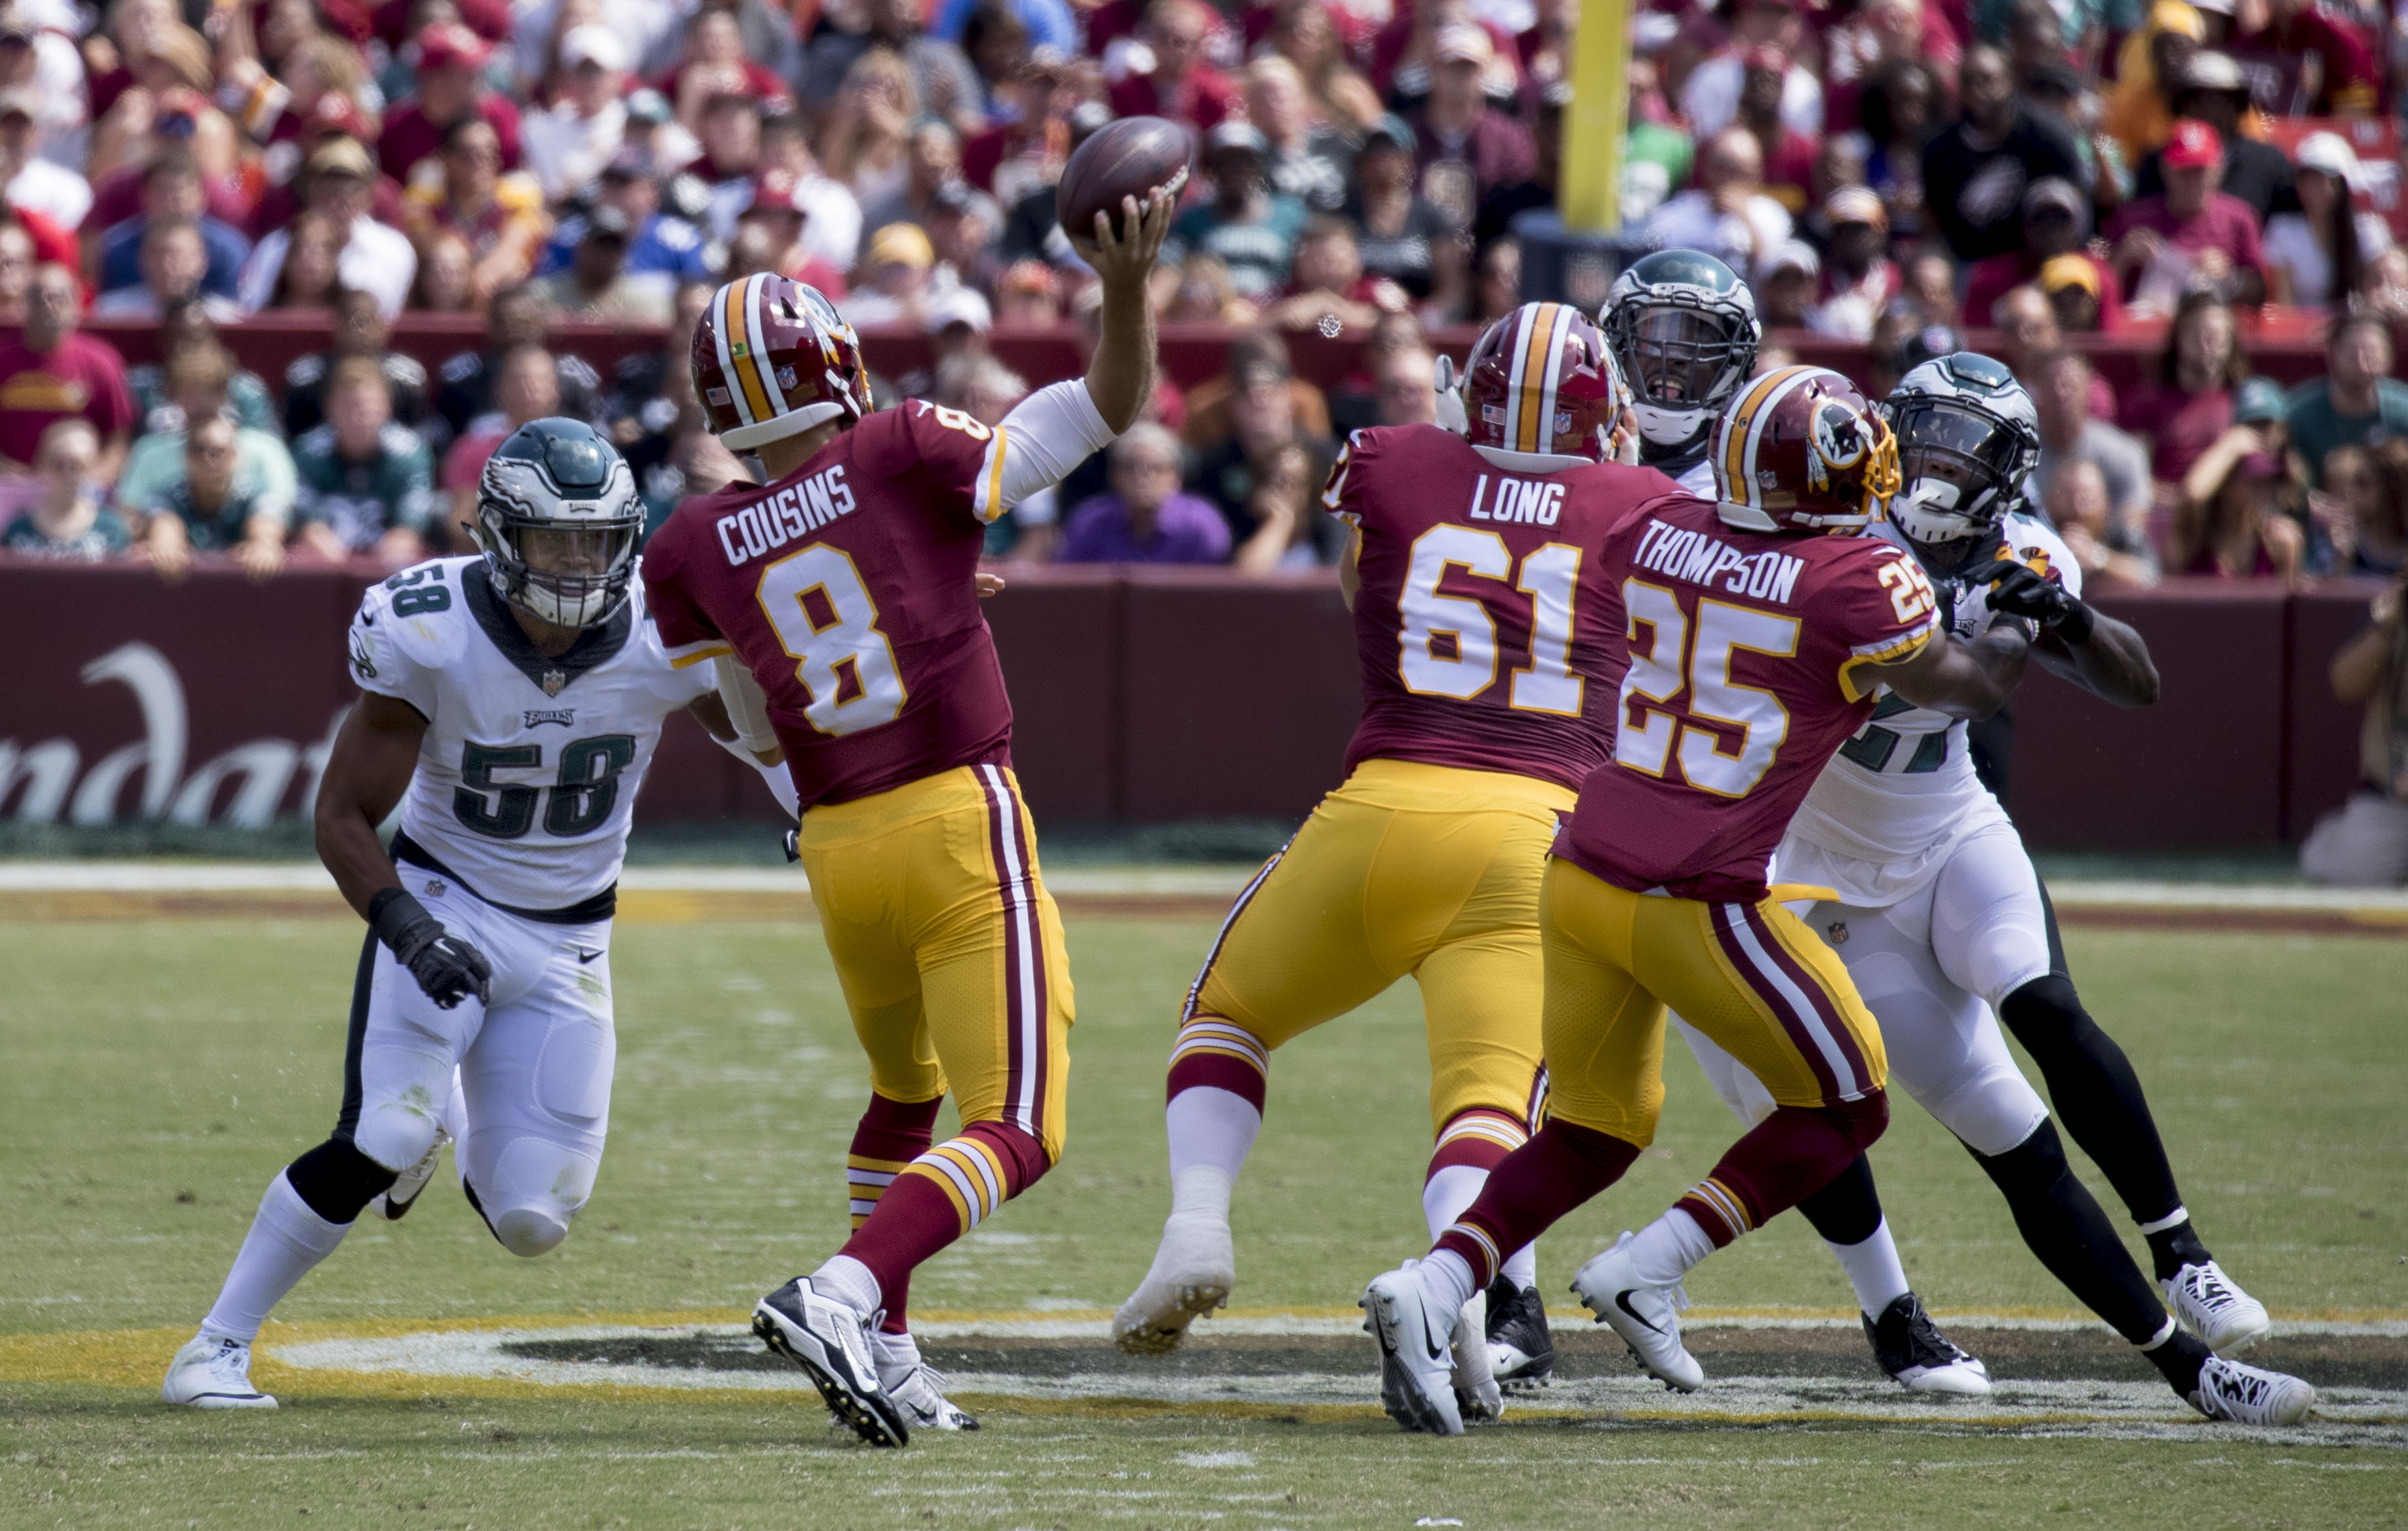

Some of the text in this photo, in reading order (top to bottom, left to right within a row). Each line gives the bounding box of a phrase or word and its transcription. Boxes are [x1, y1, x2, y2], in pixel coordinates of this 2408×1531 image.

[936, 404, 992, 440] 8
[717, 464, 857, 567] COUSINS
[1470, 473, 1566, 526] LONG
[385, 564, 452, 618] 58
[1634, 518, 1805, 604] THOMPSON
[1878, 553, 1935, 625] 25
[755, 541, 909, 737] 8
[1398, 522, 1586, 718] 61
[1615, 575, 1803, 799] 25
[452, 733, 637, 840] 58
